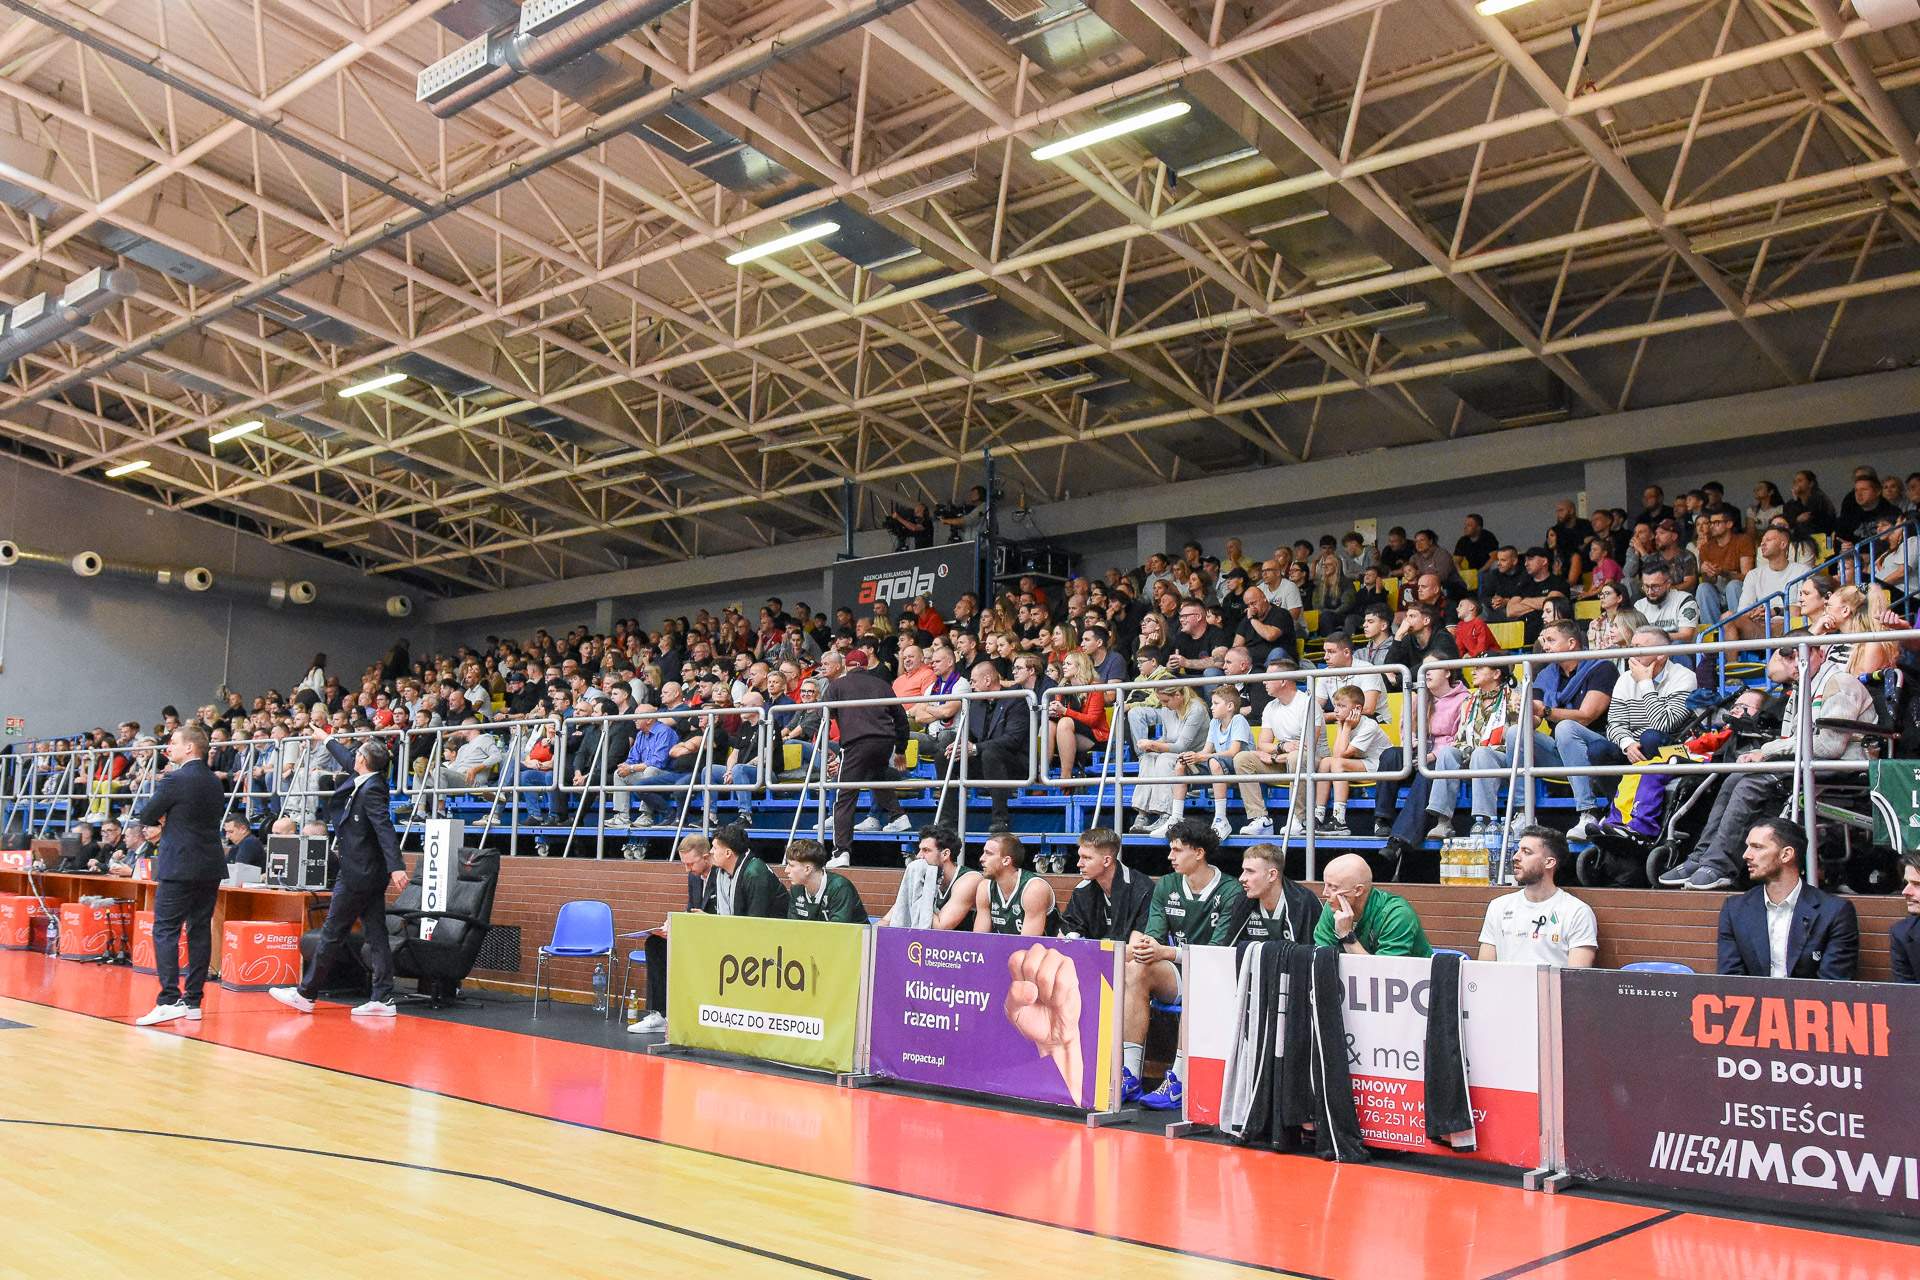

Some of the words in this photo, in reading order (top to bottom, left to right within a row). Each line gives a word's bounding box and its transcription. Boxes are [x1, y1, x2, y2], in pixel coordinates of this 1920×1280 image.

[427, 830, 439, 922] OLIPOL
[1210, 912, 1219, 927] 2
[925, 948, 985, 964] PROPACTA
[925, 959, 961, 969] Ubezpieczenia
[719, 946, 805, 996] perla
[905, 980, 990, 1011] Kibicujemy
[1618, 988, 1678, 998] SIERLECCY
[702, 1009, 744, 1028] DOŁĄCZ
[747, 1015, 764, 1028] DO
[768, 1017, 820, 1036] ZESPOŁU
[904, 1009, 950, 1030] razem
[954, 1013, 960, 1032] !
[1690, 993, 1890, 1057] CZARNI
[902, 1051, 945, 1066] propacta.pl
[1717, 1057, 1762, 1081] DO
[1770, 1060, 1864, 1090] BOJU!
[1352, 1078, 1408, 1095] RMOWY
[1367, 1095, 1395, 1109] Sofa
[1402, 1101, 1414, 1112] w
[1364, 1109, 1406, 1127] 76-251
[1719, 1102, 1865, 1139] JESTEŚCIE
[1360, 1128, 1425, 1145] ernational.pl
